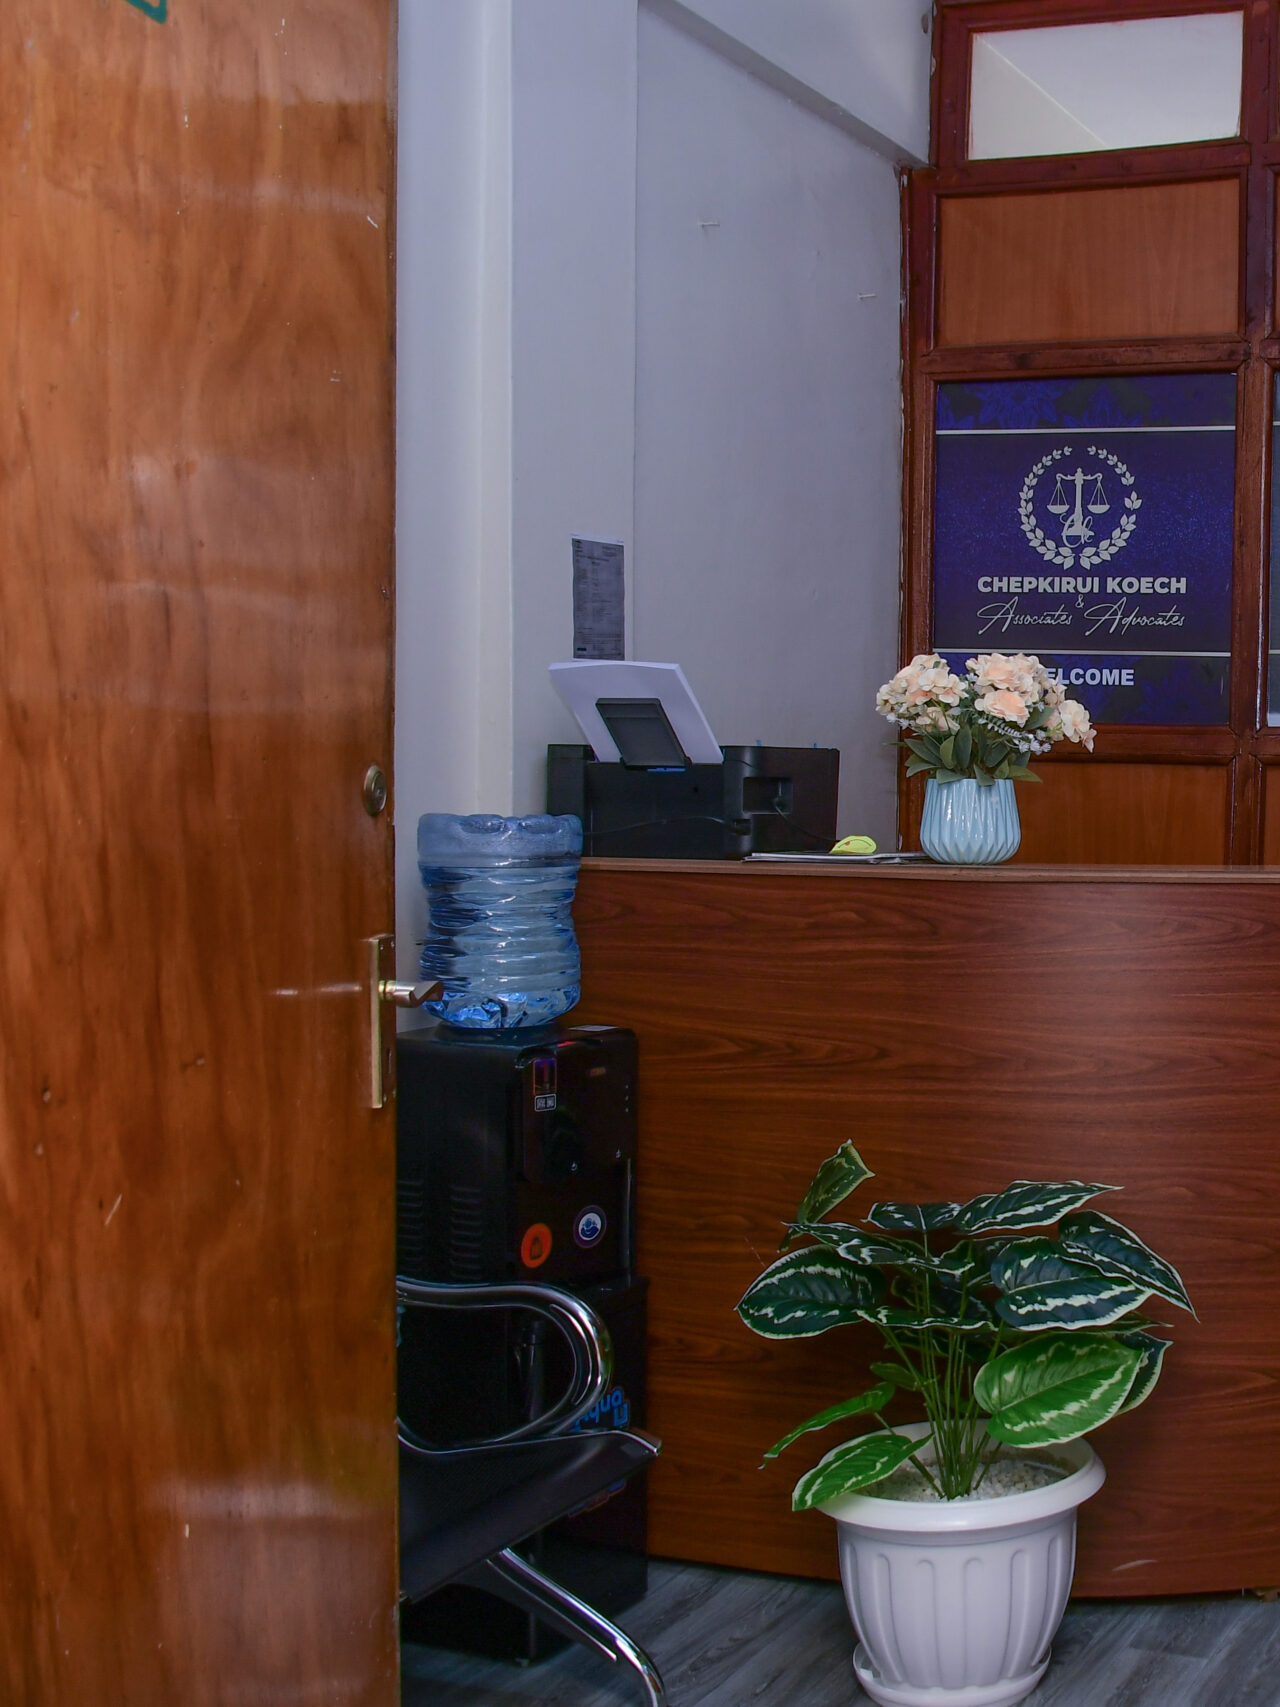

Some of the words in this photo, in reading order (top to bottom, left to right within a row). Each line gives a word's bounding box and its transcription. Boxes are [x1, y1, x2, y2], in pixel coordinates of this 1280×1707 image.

[977, 576, 1099, 594] CHEPKIRUI
[1106, 576, 1187, 594] KOECH
[1075, 594, 1085, 609] &
[977, 596, 1073, 635] Associates
[1084, 596, 1185, 636] Advocates
